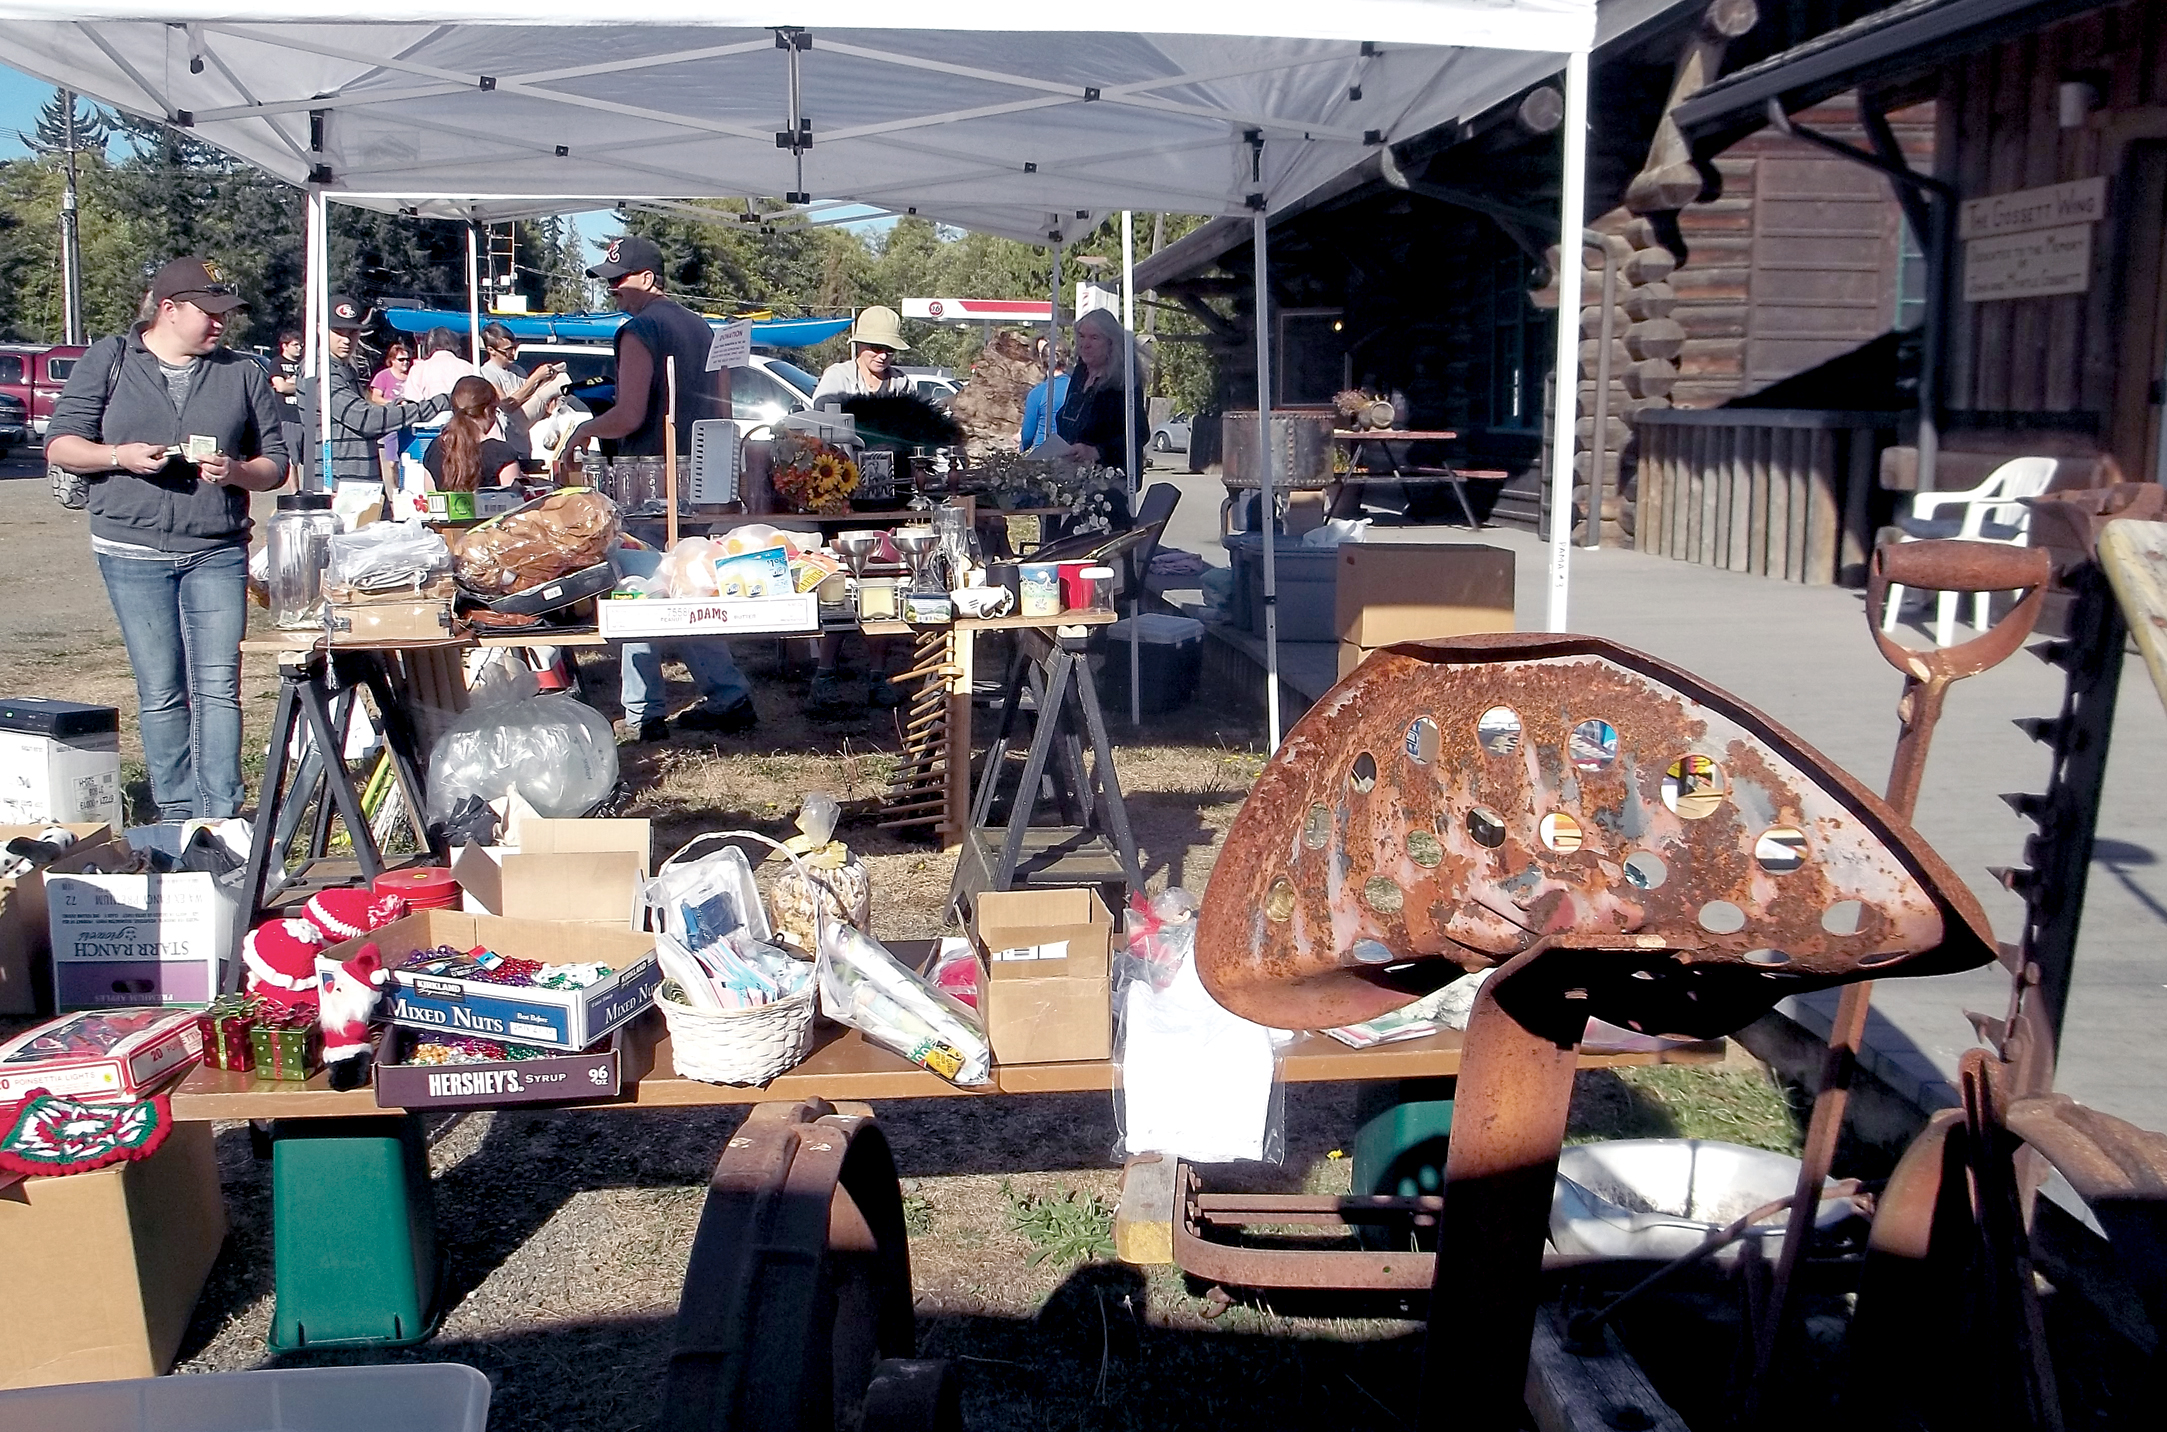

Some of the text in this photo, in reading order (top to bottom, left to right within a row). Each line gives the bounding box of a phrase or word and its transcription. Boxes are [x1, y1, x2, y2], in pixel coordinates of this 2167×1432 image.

[689, 607, 728, 624] ADAMS
[65, 895, 77, 906] 72
[73, 941, 190, 957] STARR RANCH
[417, 979, 462, 994] KIRKLAND
[394, 998, 505, 1033] MIXED NUTS
[605, 997, 637, 1025] MIXED
[151, 1047, 163, 1062] 20
[0, 1071, 96, 1091] 0 POINSETTIA LIGHTS
[525, 1073, 567, 1084] SYRUP
[588, 1065, 609, 1083] 96
